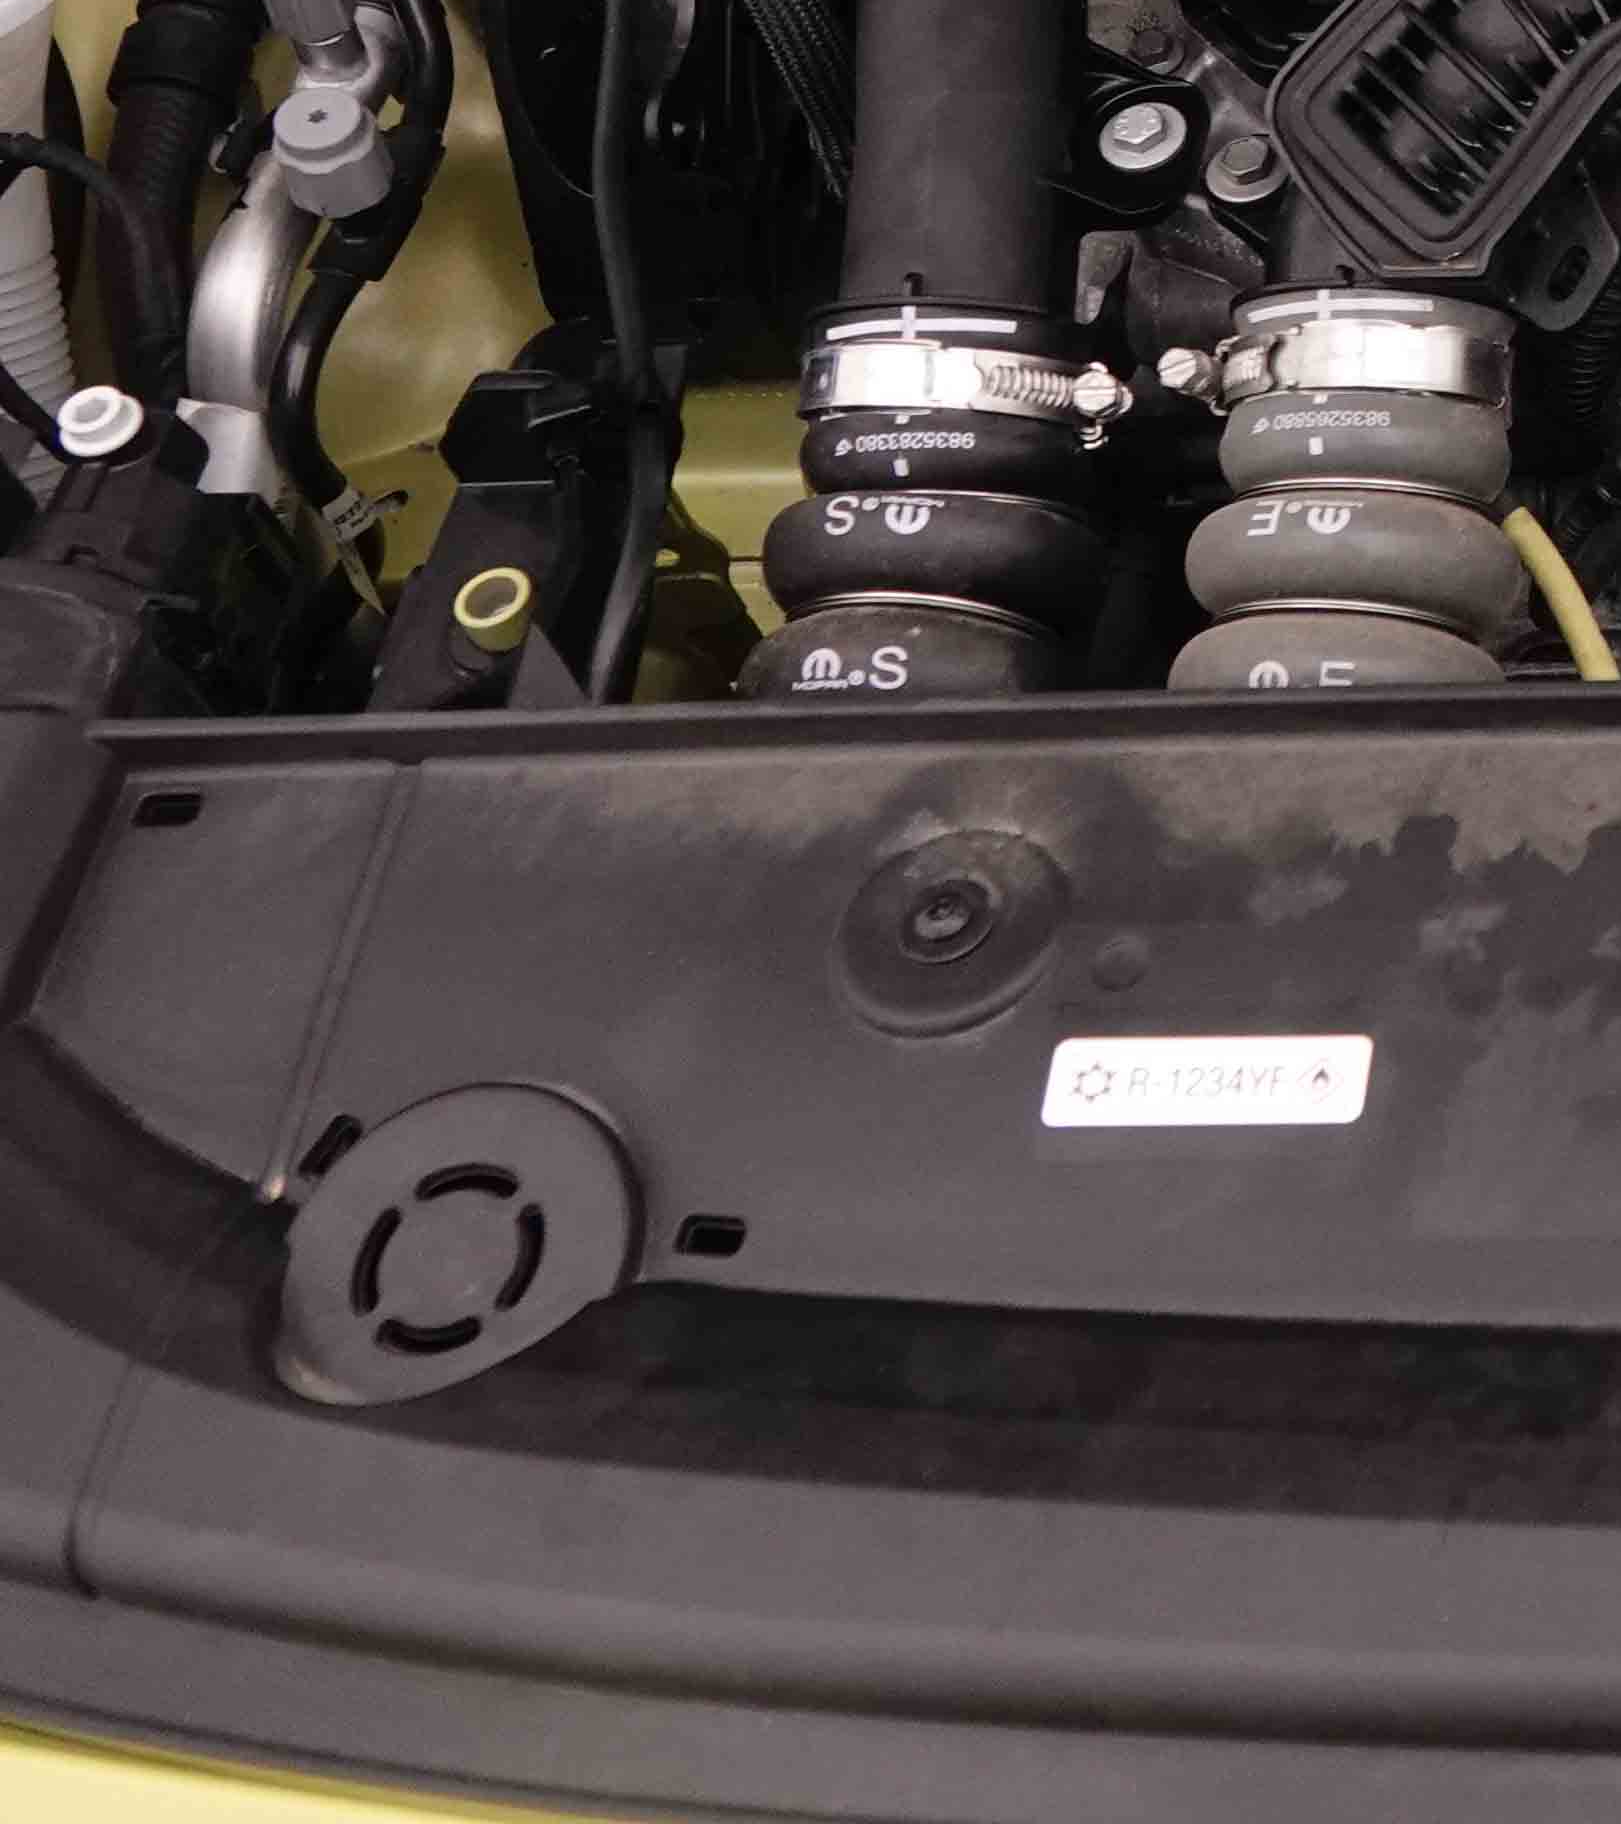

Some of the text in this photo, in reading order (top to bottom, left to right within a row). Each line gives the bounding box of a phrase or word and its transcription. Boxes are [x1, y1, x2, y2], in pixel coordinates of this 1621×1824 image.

[823, 495, 860, 536] S
[1247, 500, 1287, 537] E
[868, 645, 909, 691] S
